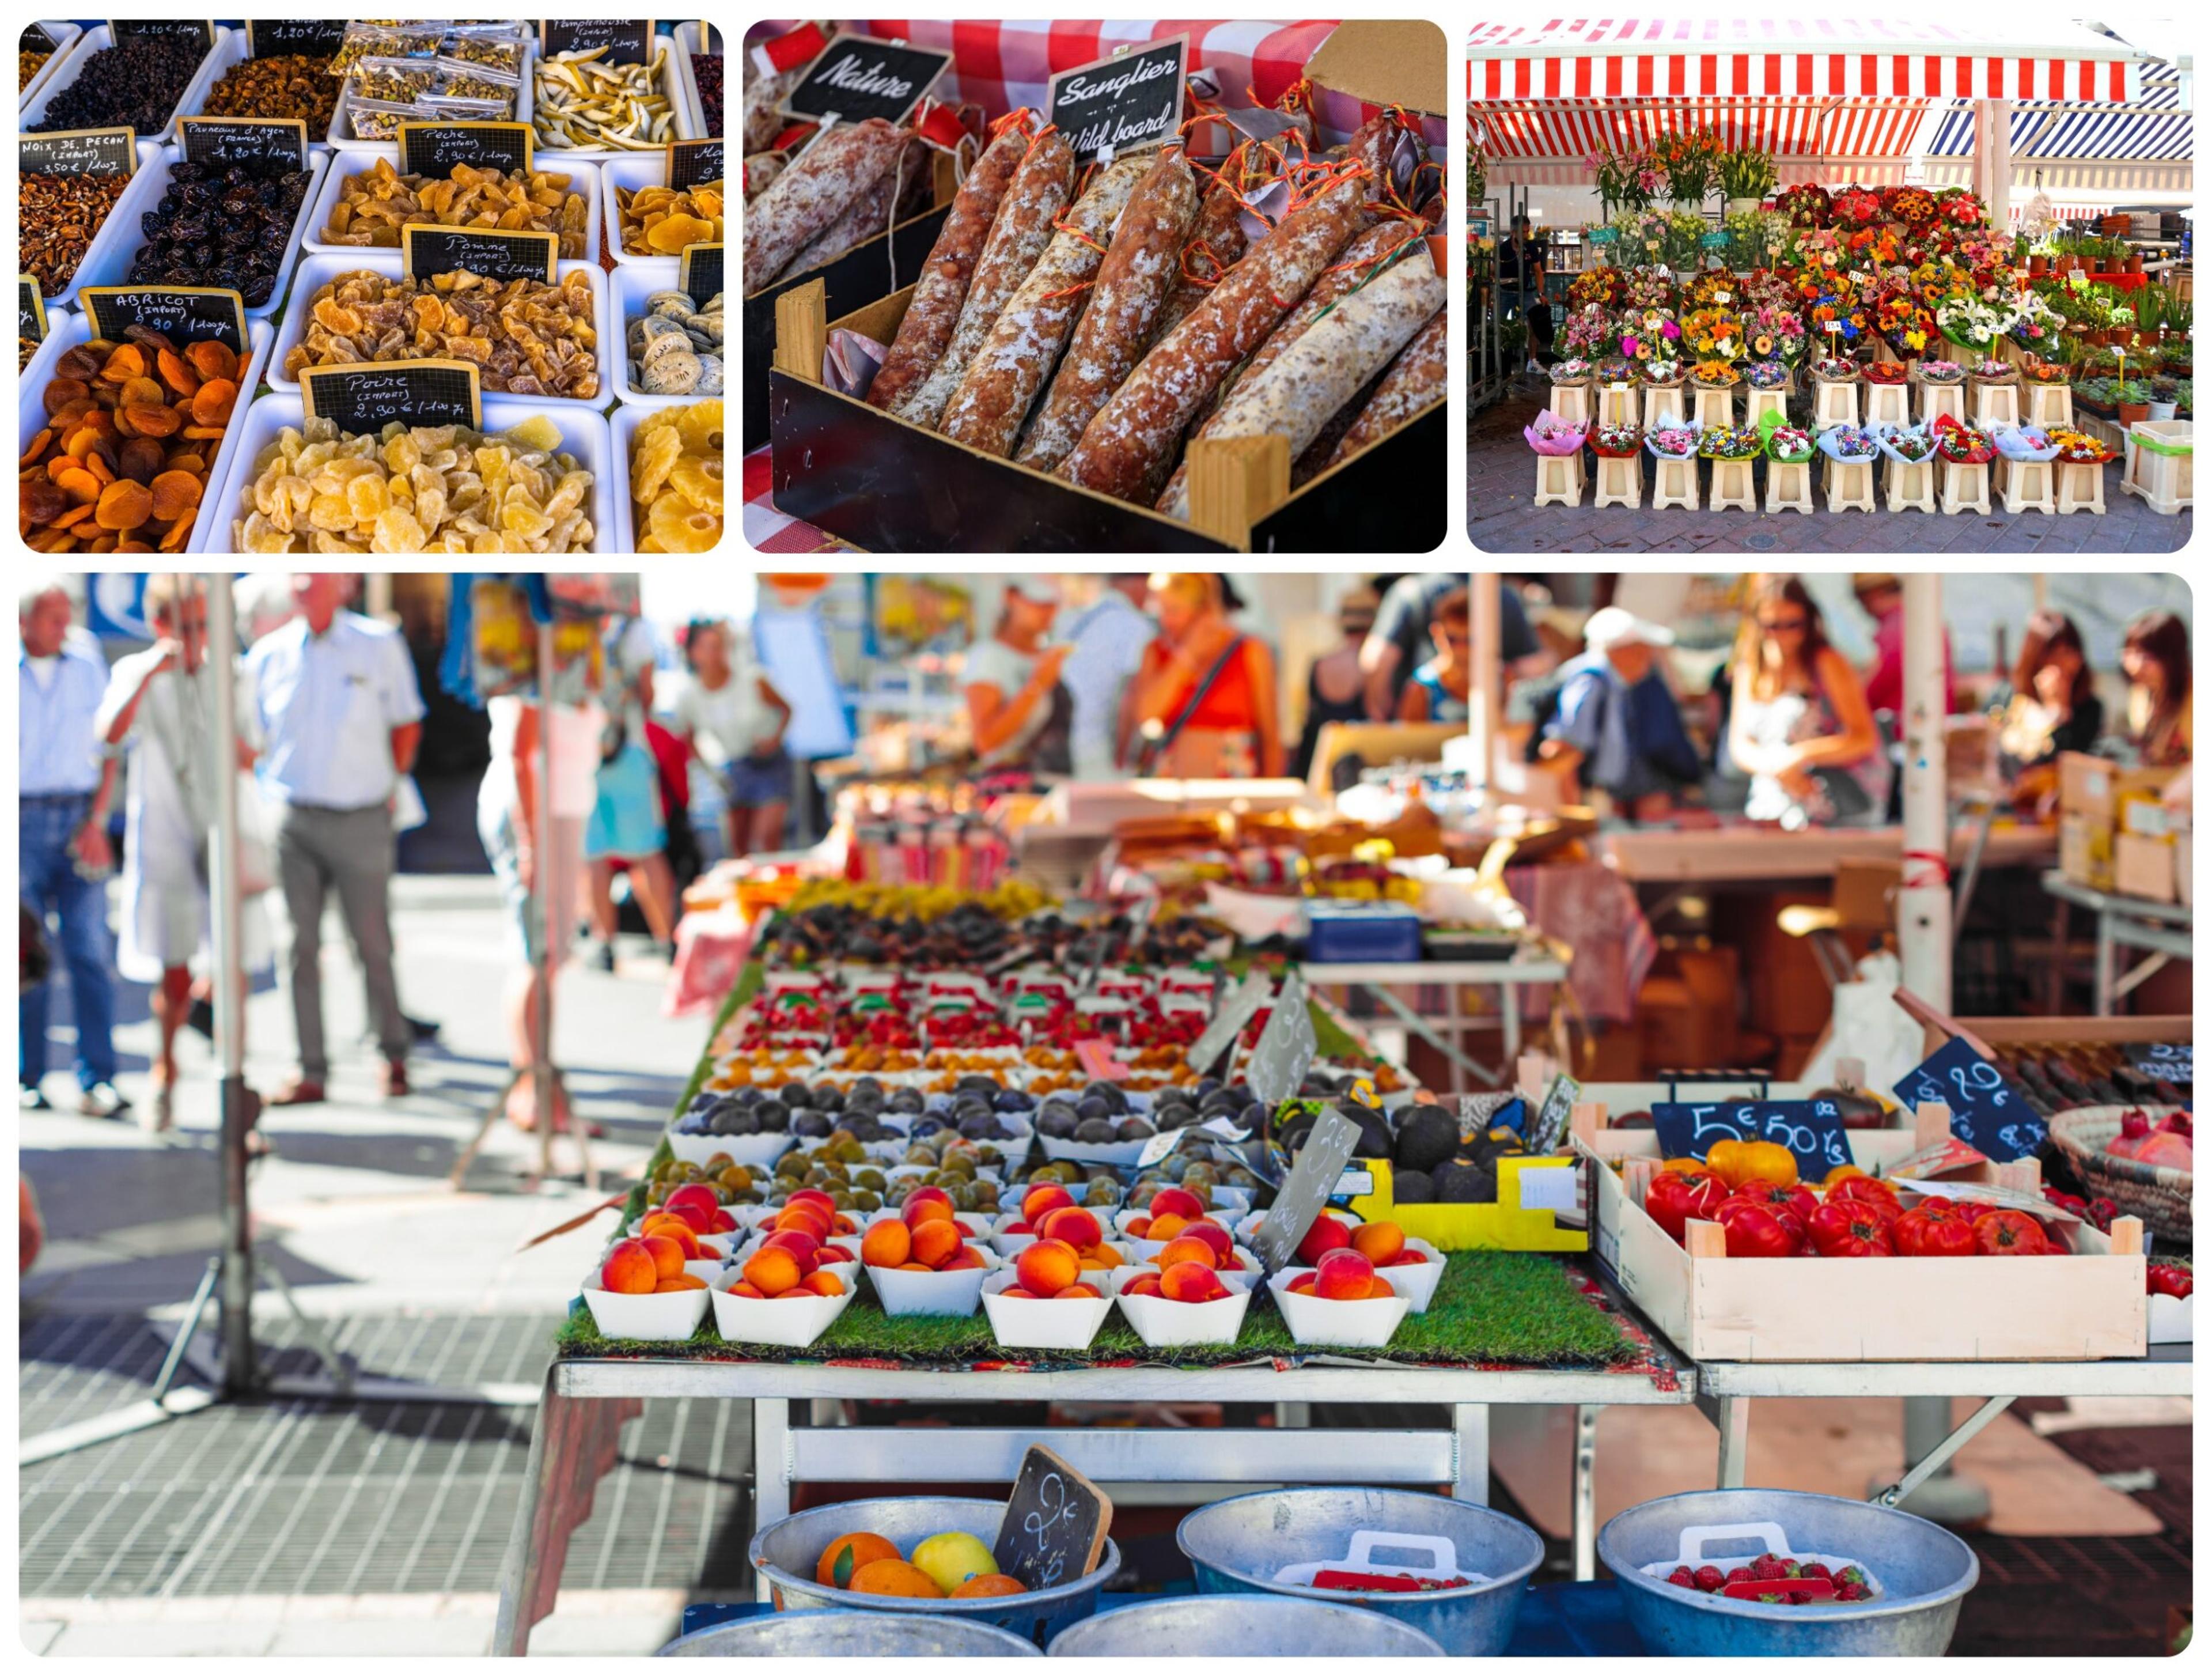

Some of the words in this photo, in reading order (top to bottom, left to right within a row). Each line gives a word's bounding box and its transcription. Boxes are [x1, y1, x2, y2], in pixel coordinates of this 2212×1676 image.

[814, 53, 913, 99] Nature
[1056, 57, 1177, 106] Sanglier
[187, 123, 237, 134] Pruneaux
[1111, 101, 1172, 146] board
[86, 135, 127, 147] PECAN
[218, 135, 262, 144] (FRANCE)
[445, 234, 507, 252] Pomme
[137, 306, 187, 319] (IMPORT)
[346, 374, 408, 391] Poire
[357, 389, 410, 402] (IMPORT)
